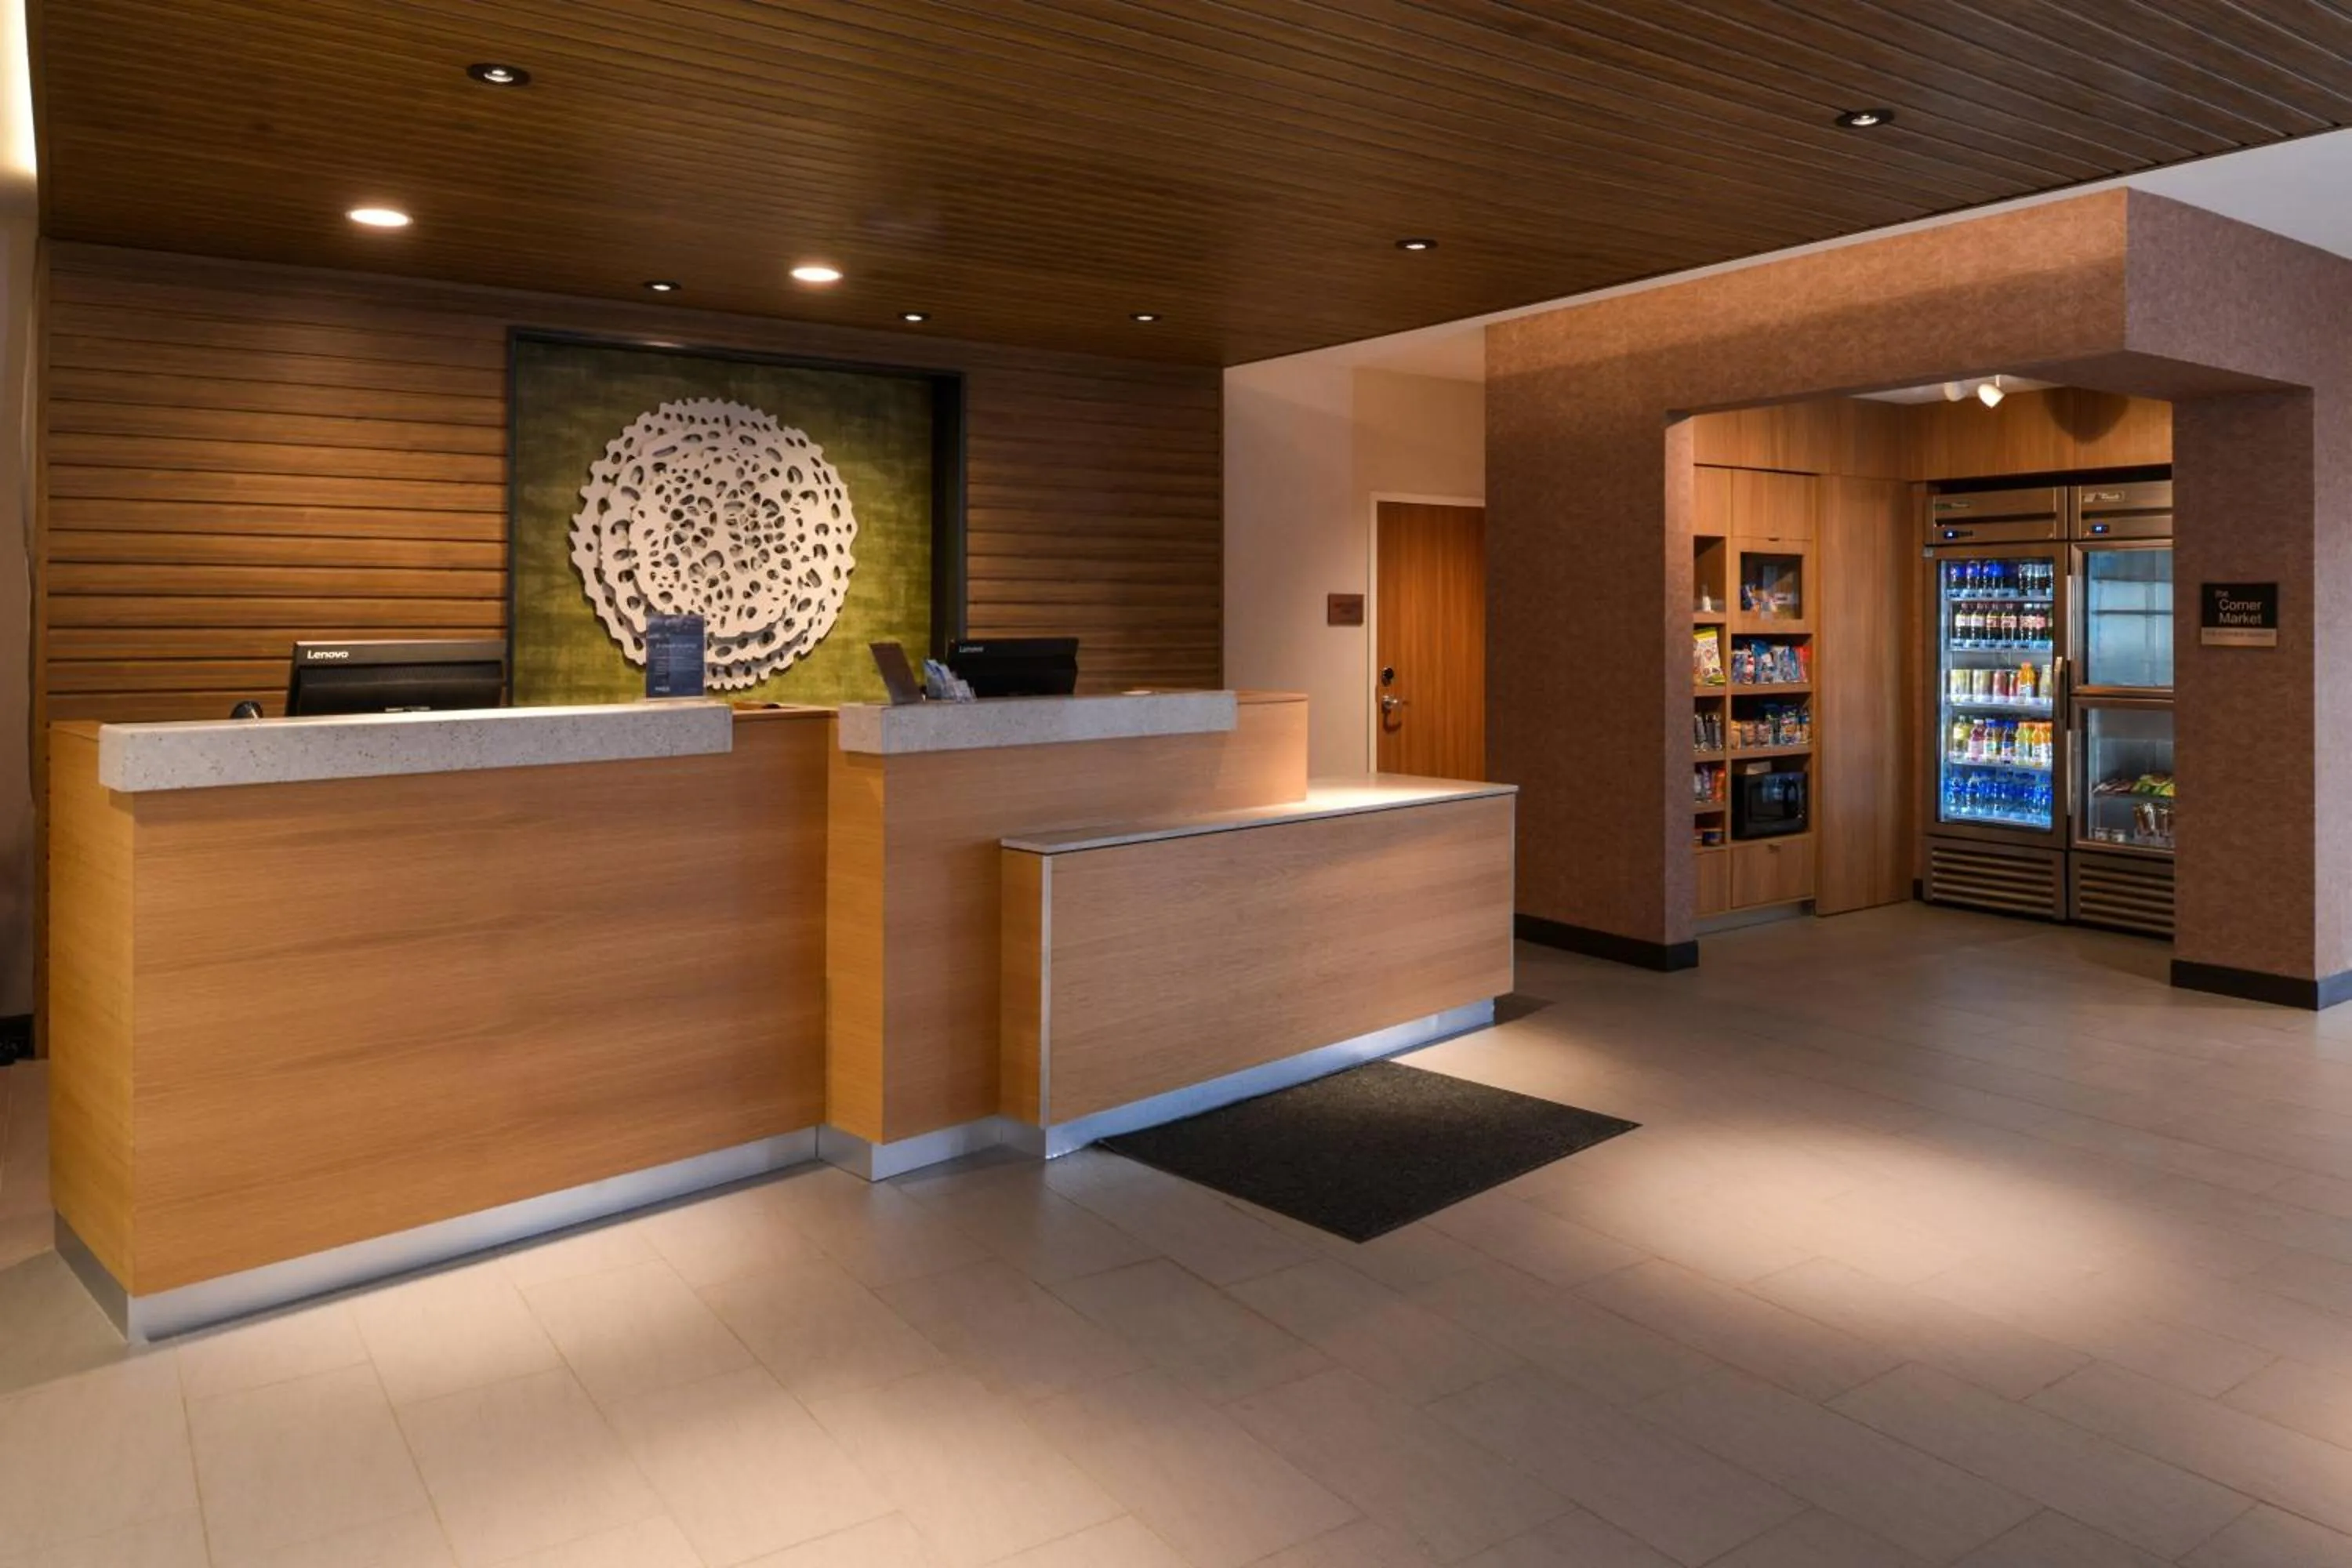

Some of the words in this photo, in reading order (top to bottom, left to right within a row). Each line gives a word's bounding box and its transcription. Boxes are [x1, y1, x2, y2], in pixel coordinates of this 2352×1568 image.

[2220, 598, 2262, 611] Corner
[2220, 612, 2262, 624] Market
[307, 650, 349, 659] Lenovo
